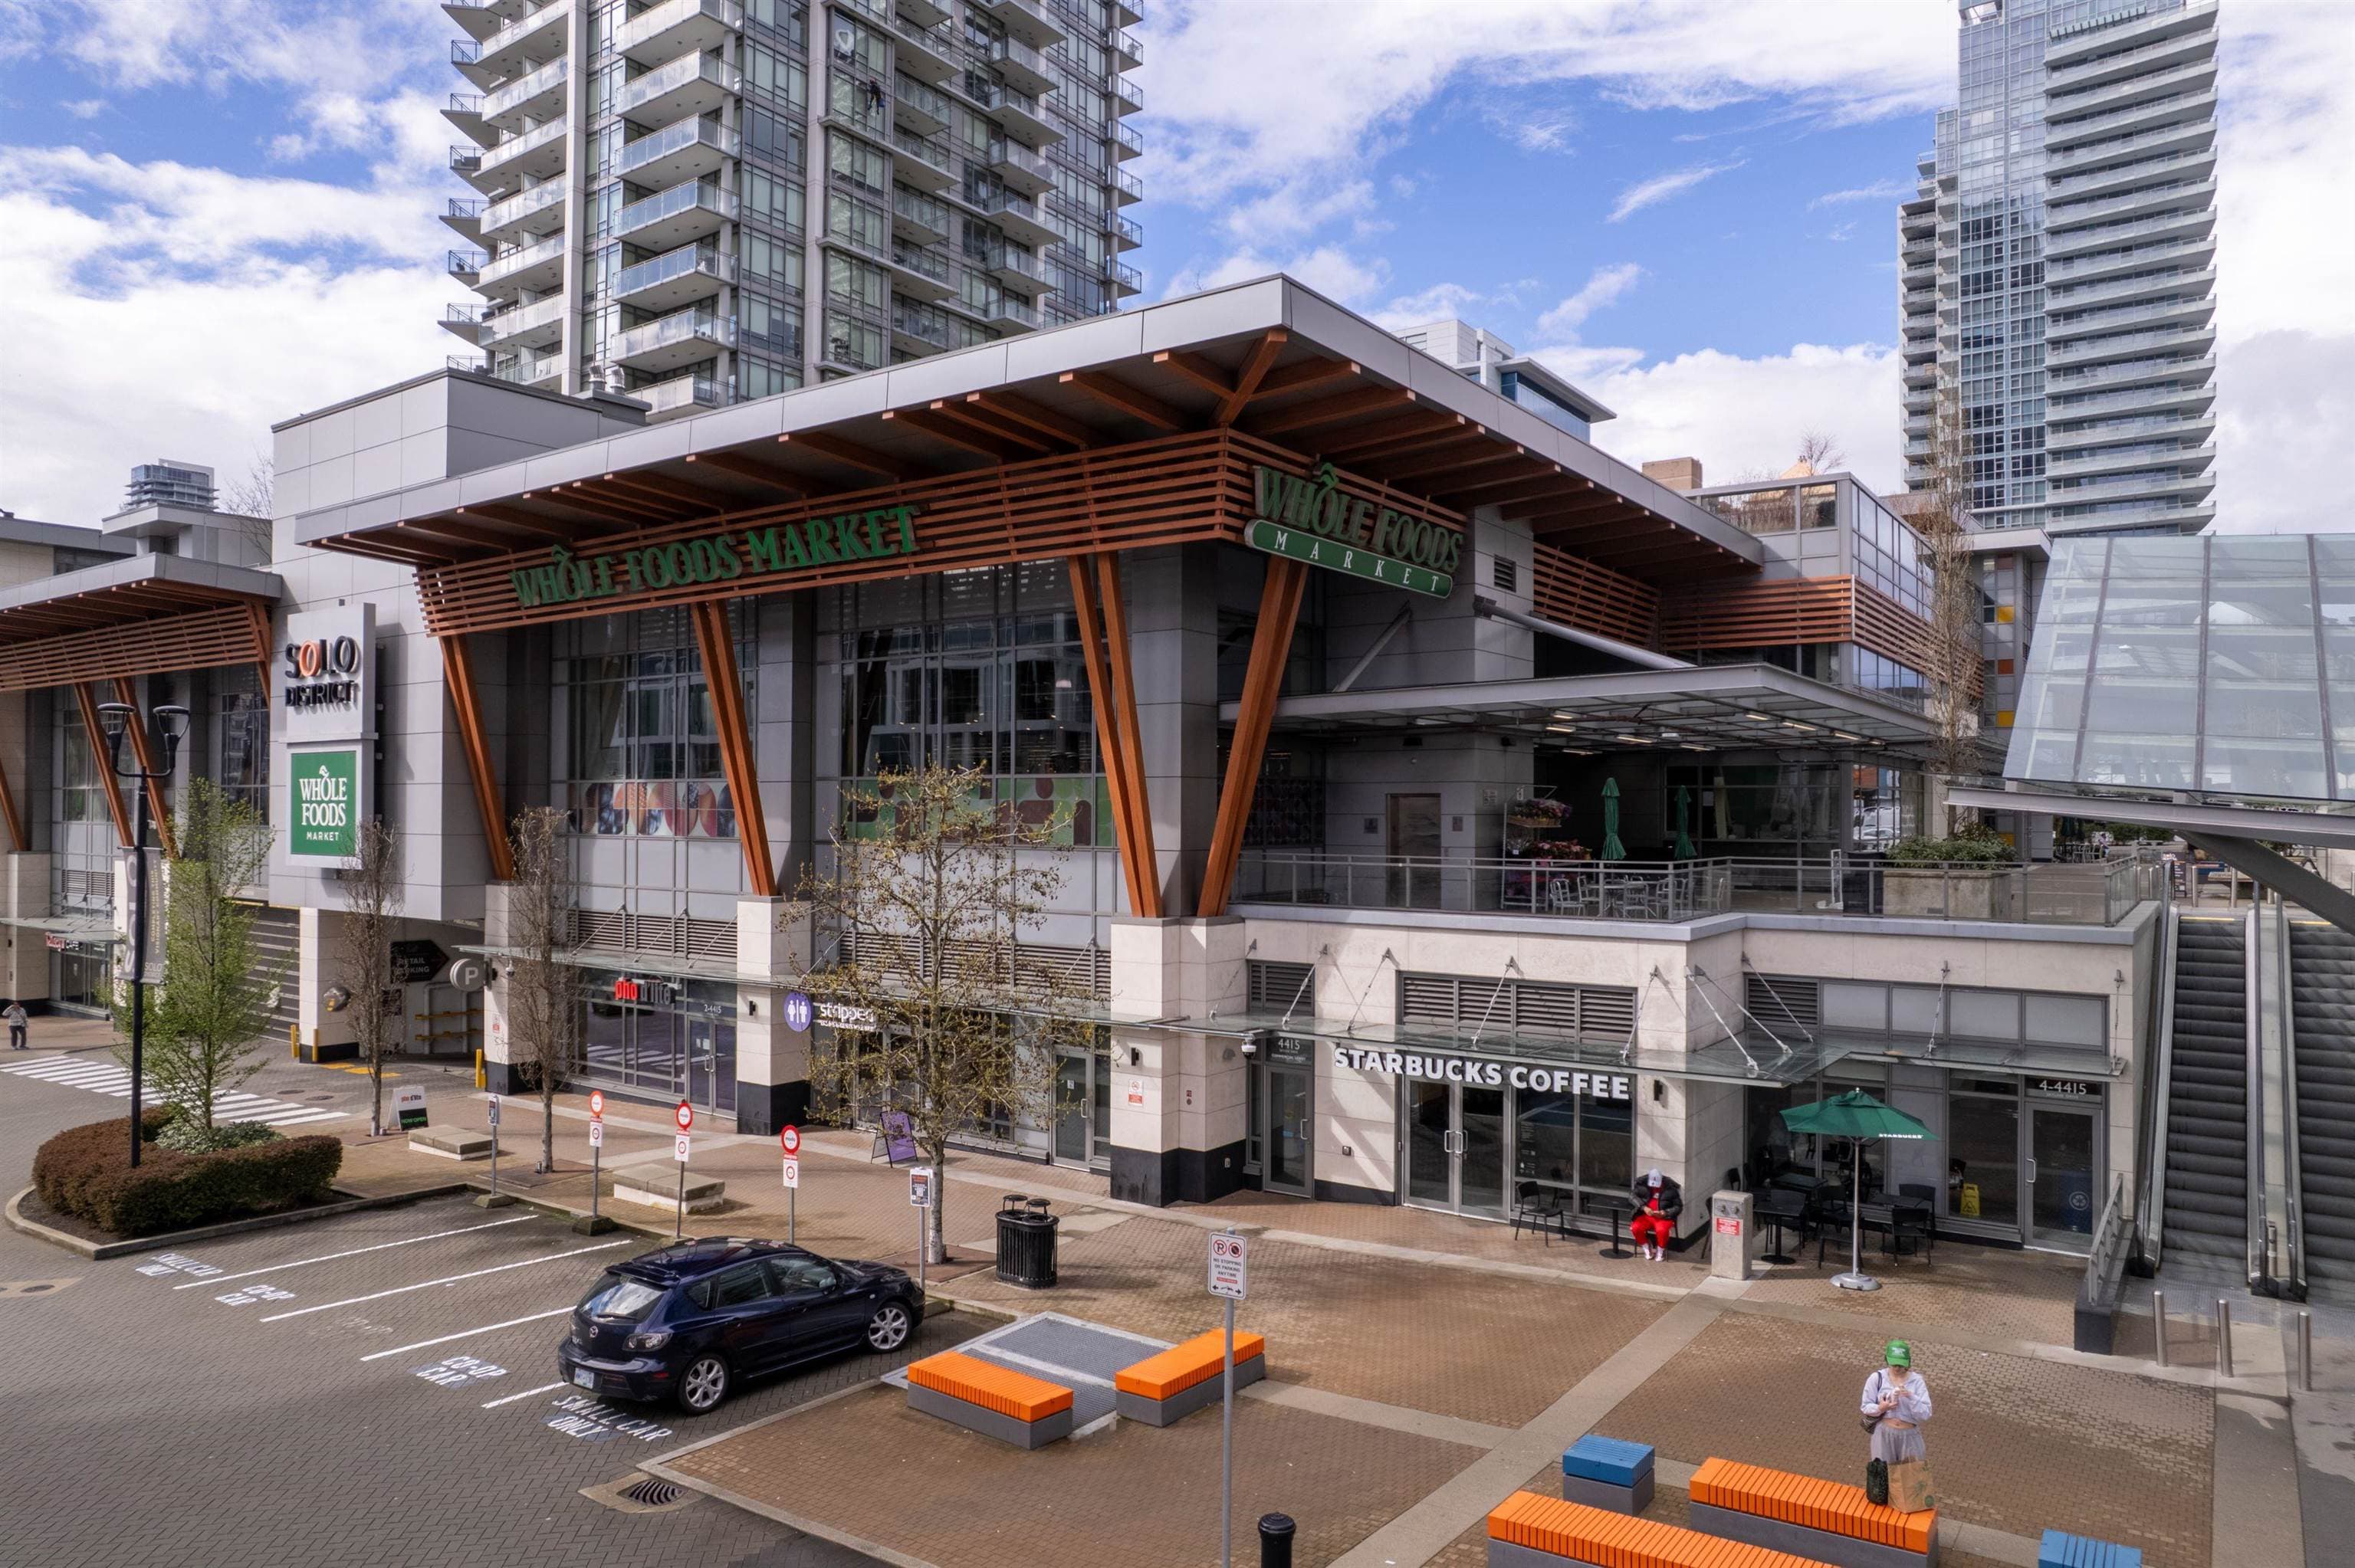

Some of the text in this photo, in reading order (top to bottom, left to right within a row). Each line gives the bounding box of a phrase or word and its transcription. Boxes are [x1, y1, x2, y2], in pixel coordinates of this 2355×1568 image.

[1254, 465, 1463, 573] WHOLE FOODS
[508, 505, 920, 607] WHOLE FOODS MARKET
[1273, 530, 1439, 592] MARKET
[284, 635, 359, 679] SOLO
[284, 681, 356, 707] DISTRICT
[299, 776, 347, 801] WHOLE
[301, 802, 346, 826] FOODS
[307, 832, 339, 841] MARKET
[465, 967, 478, 985] P
[615, 980, 672, 1005] pho d'lite
[704, 1004, 722, 1014] 2-4415
[1278, 1038, 1300, 1050] 4415
[1334, 1048, 1629, 1100] STARBUCKS COFFEE
[2039, 1080, 2087, 1095] 4-4415
[215, 1293, 258, 1306] CAR
[242, 1284, 295, 1301] CO-OP
[416, 1366, 468, 1386] CAR
[441, 1356, 507, 1379] CO-OP
[547, 1415, 609, 1438] ONLY
[552, 1395, 672, 1442] SMALL CAR
